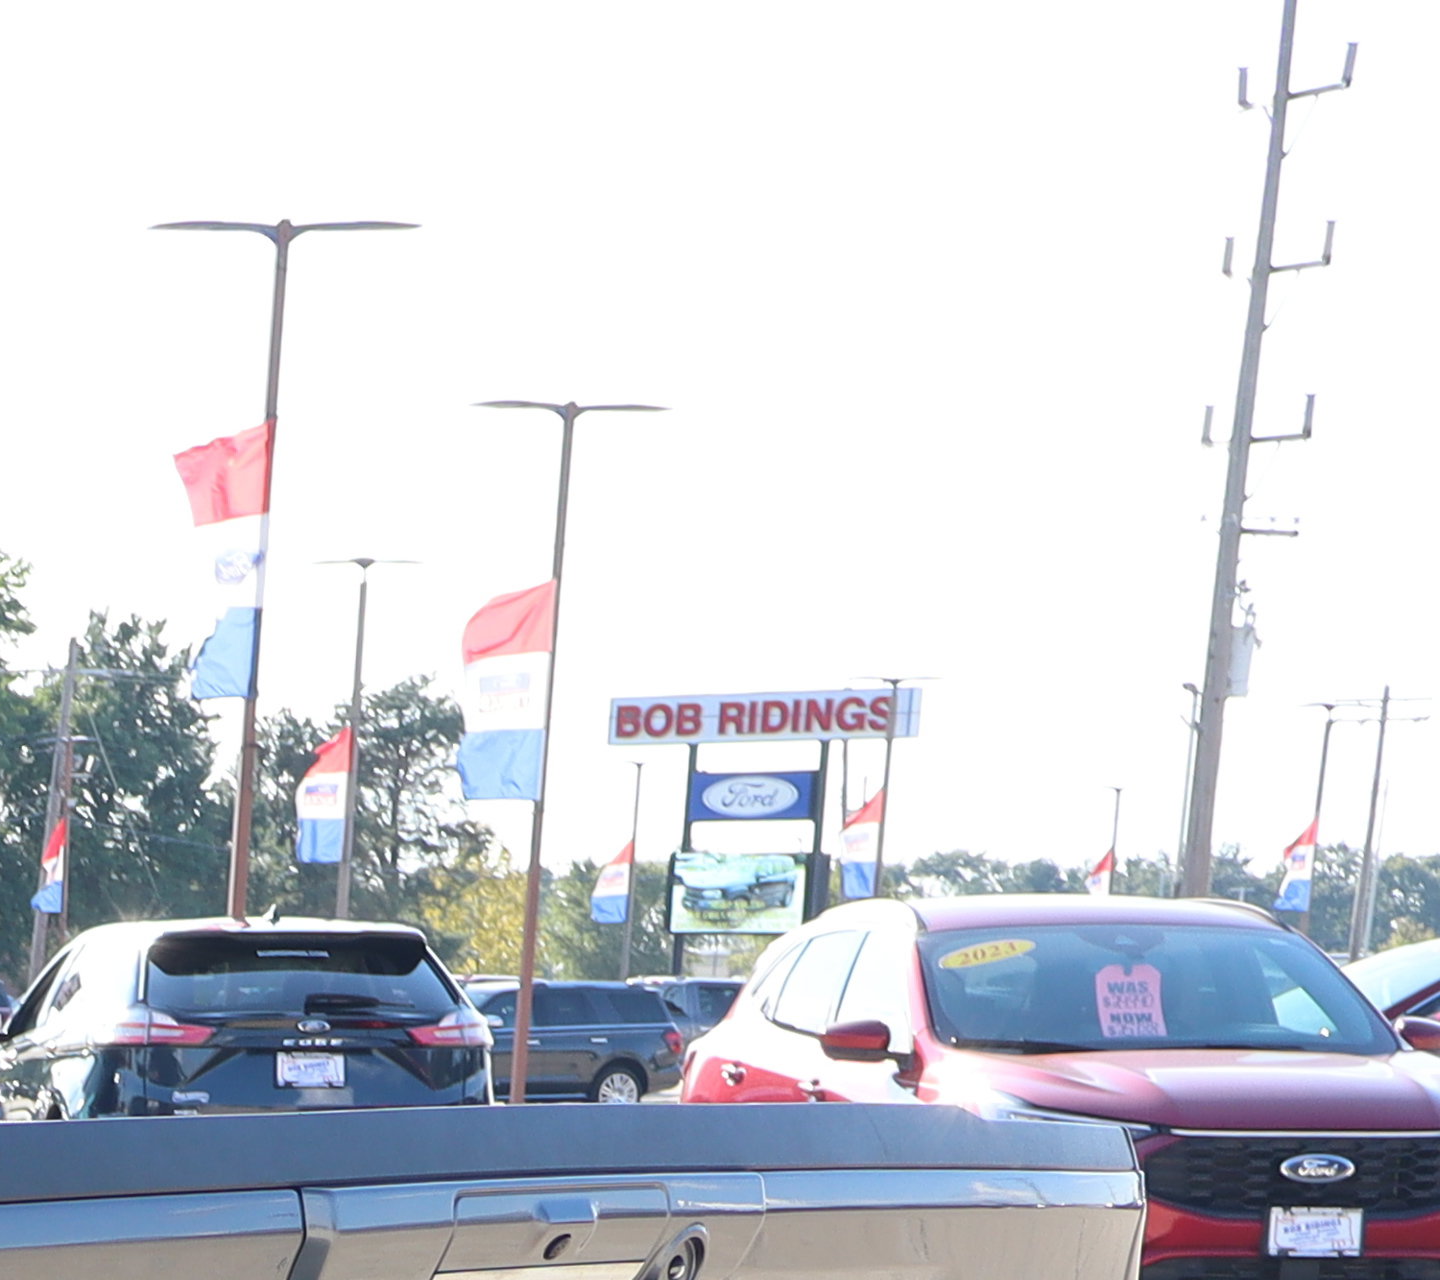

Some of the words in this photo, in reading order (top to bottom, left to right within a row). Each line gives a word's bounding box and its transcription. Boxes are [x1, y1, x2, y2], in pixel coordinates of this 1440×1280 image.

[616, 703, 702, 739] BOB
[718, 696, 892, 736] RIDINGS
[720, 782, 780, 809] Ford
[1107, 981, 1149, 994] WAS
[1110, 1012, 1153, 1024] NOW
[1298, 1159, 1339, 1176] Ford
